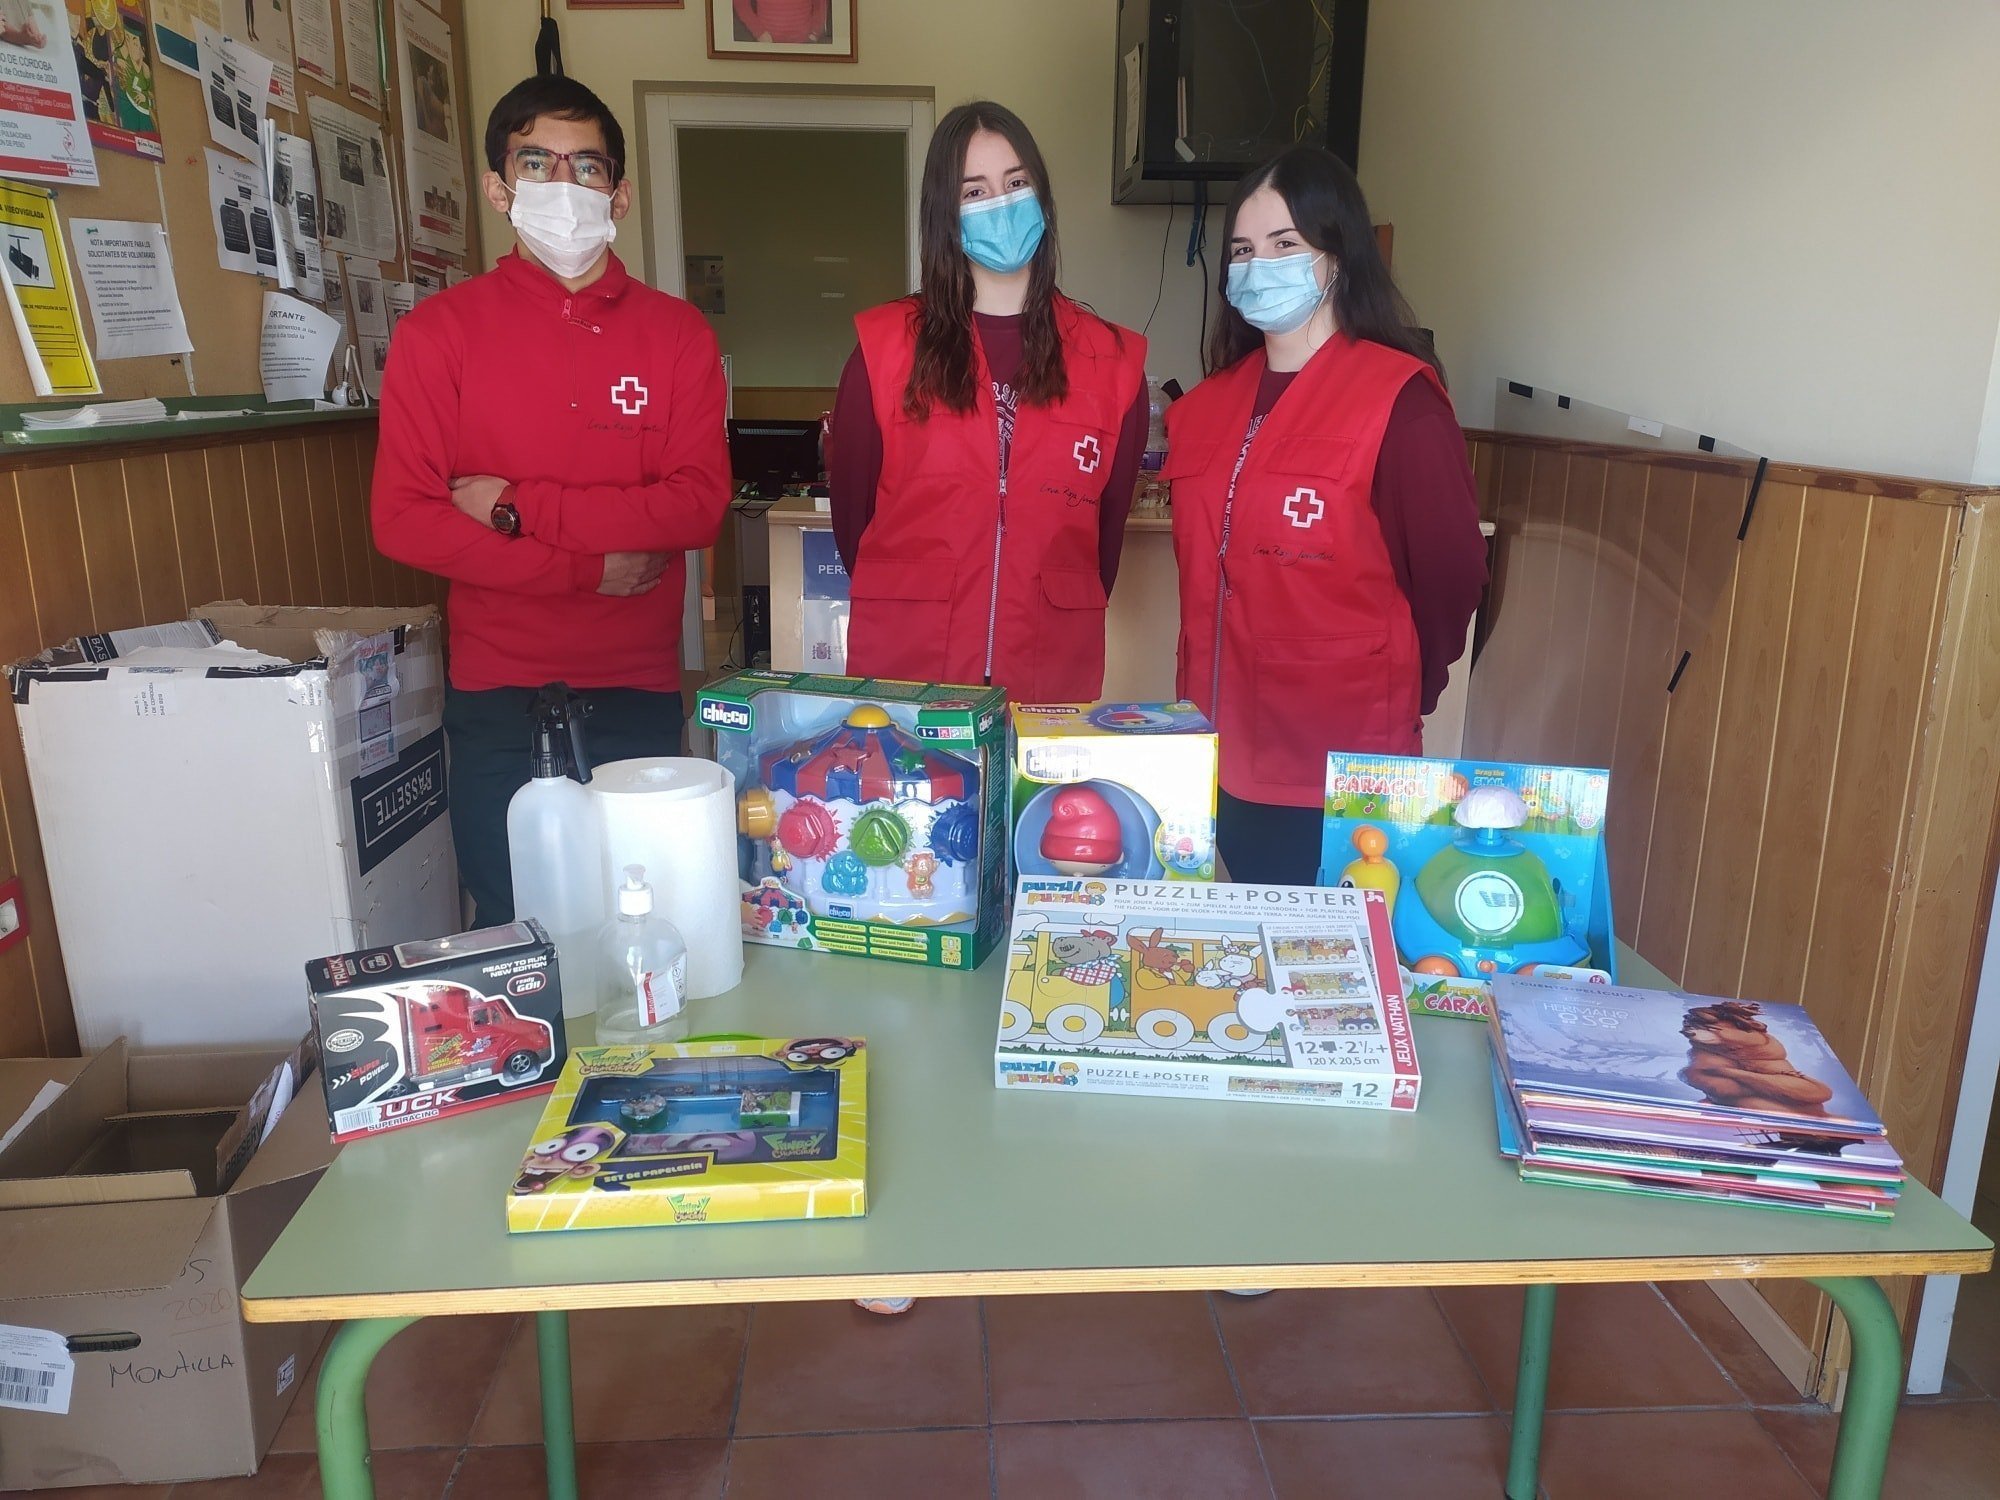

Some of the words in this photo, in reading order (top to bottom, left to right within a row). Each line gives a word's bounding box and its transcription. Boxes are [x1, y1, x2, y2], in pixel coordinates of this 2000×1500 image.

[90, 239, 103, 247] NOTA
[104, 240, 134, 248] IMPORTANTE
[88, 250, 121, 258] SOLICITANTES
[91, 637, 107, 660] BAS
[702, 702, 749, 726] chicco
[1332, 774, 1430, 798] CARACOL
[375, 766, 433, 827] BASSETTE
[328, 956, 349, 987] TRUCK
[482, 963, 513, 974] READY
[528, 955, 547, 964] RUN
[490, 969, 512, 978] NEW
[513, 961, 548, 973] EDITION
[516, 977, 535, 985] ready
[1385, 993, 1407, 1037] NATHAN
[1543, 1002, 1630, 1019] HERMANO
[1557, 1012, 1620, 1030] OSO
[1295, 1041, 1318, 1054] 12
[1394, 1038, 1413, 1068] JEUX
[1308, 1057, 1326, 1065] 120
[1328, 1057, 1336, 1065] X
[1339, 1057, 1360, 1066] 20,5
[1352, 1082, 1378, 1098] 12
[367, 1114, 403, 1131] SUPER
[402, 1109, 439, 1124] RACING
[603, 1173, 624, 1184] SET
[626, 1170, 641, 1180] DE
[109, 1350, 236, 1389] MONTILLA
